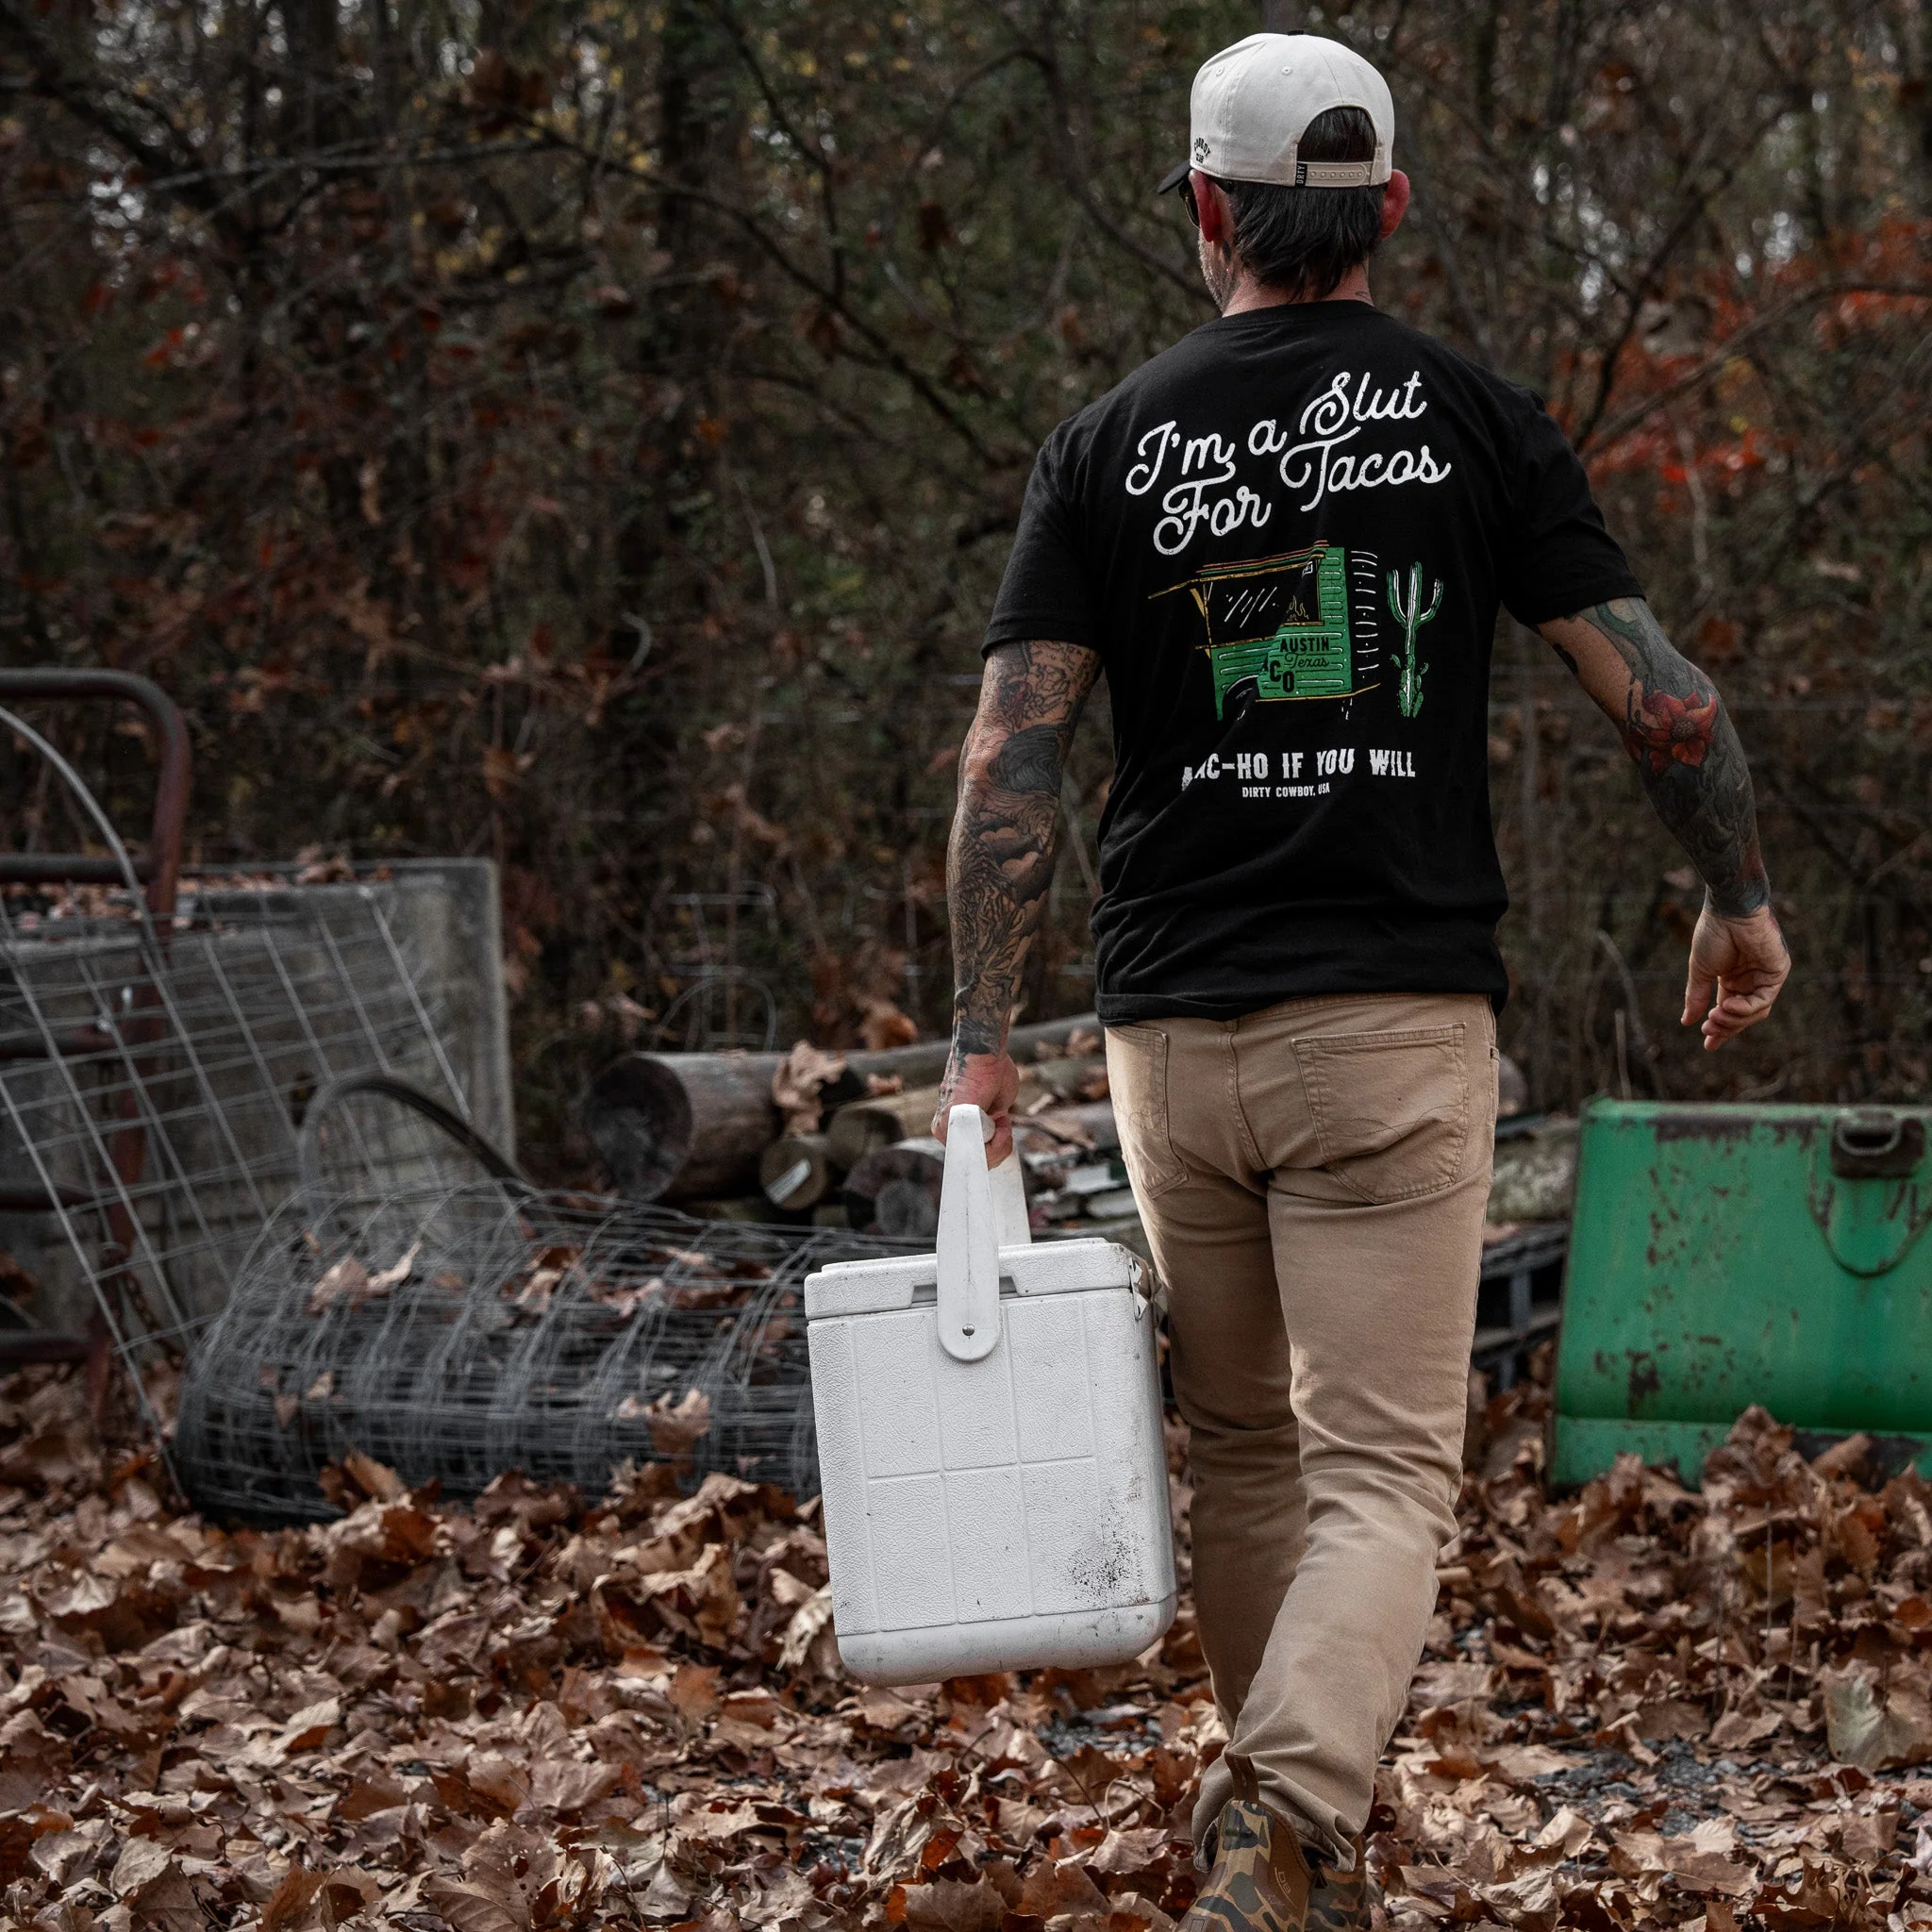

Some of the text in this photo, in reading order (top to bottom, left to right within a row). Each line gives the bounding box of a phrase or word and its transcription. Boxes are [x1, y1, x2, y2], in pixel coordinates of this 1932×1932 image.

[1125, 371, 1428, 495] I'm a Slut
[1154, 425, 1452, 555] For Tacos
[1280, 637, 1329, 652] AUSTIN
[1285, 652, 1330, 669] Texas
[1282, 753, 1304, 778] IF
[1316, 748, 1356, 776] YOU
[1370, 749, 1415, 777] WILL
[1241, 787, 1271, 797] DIRTY
[1318, 782, 1330, 794] USA
